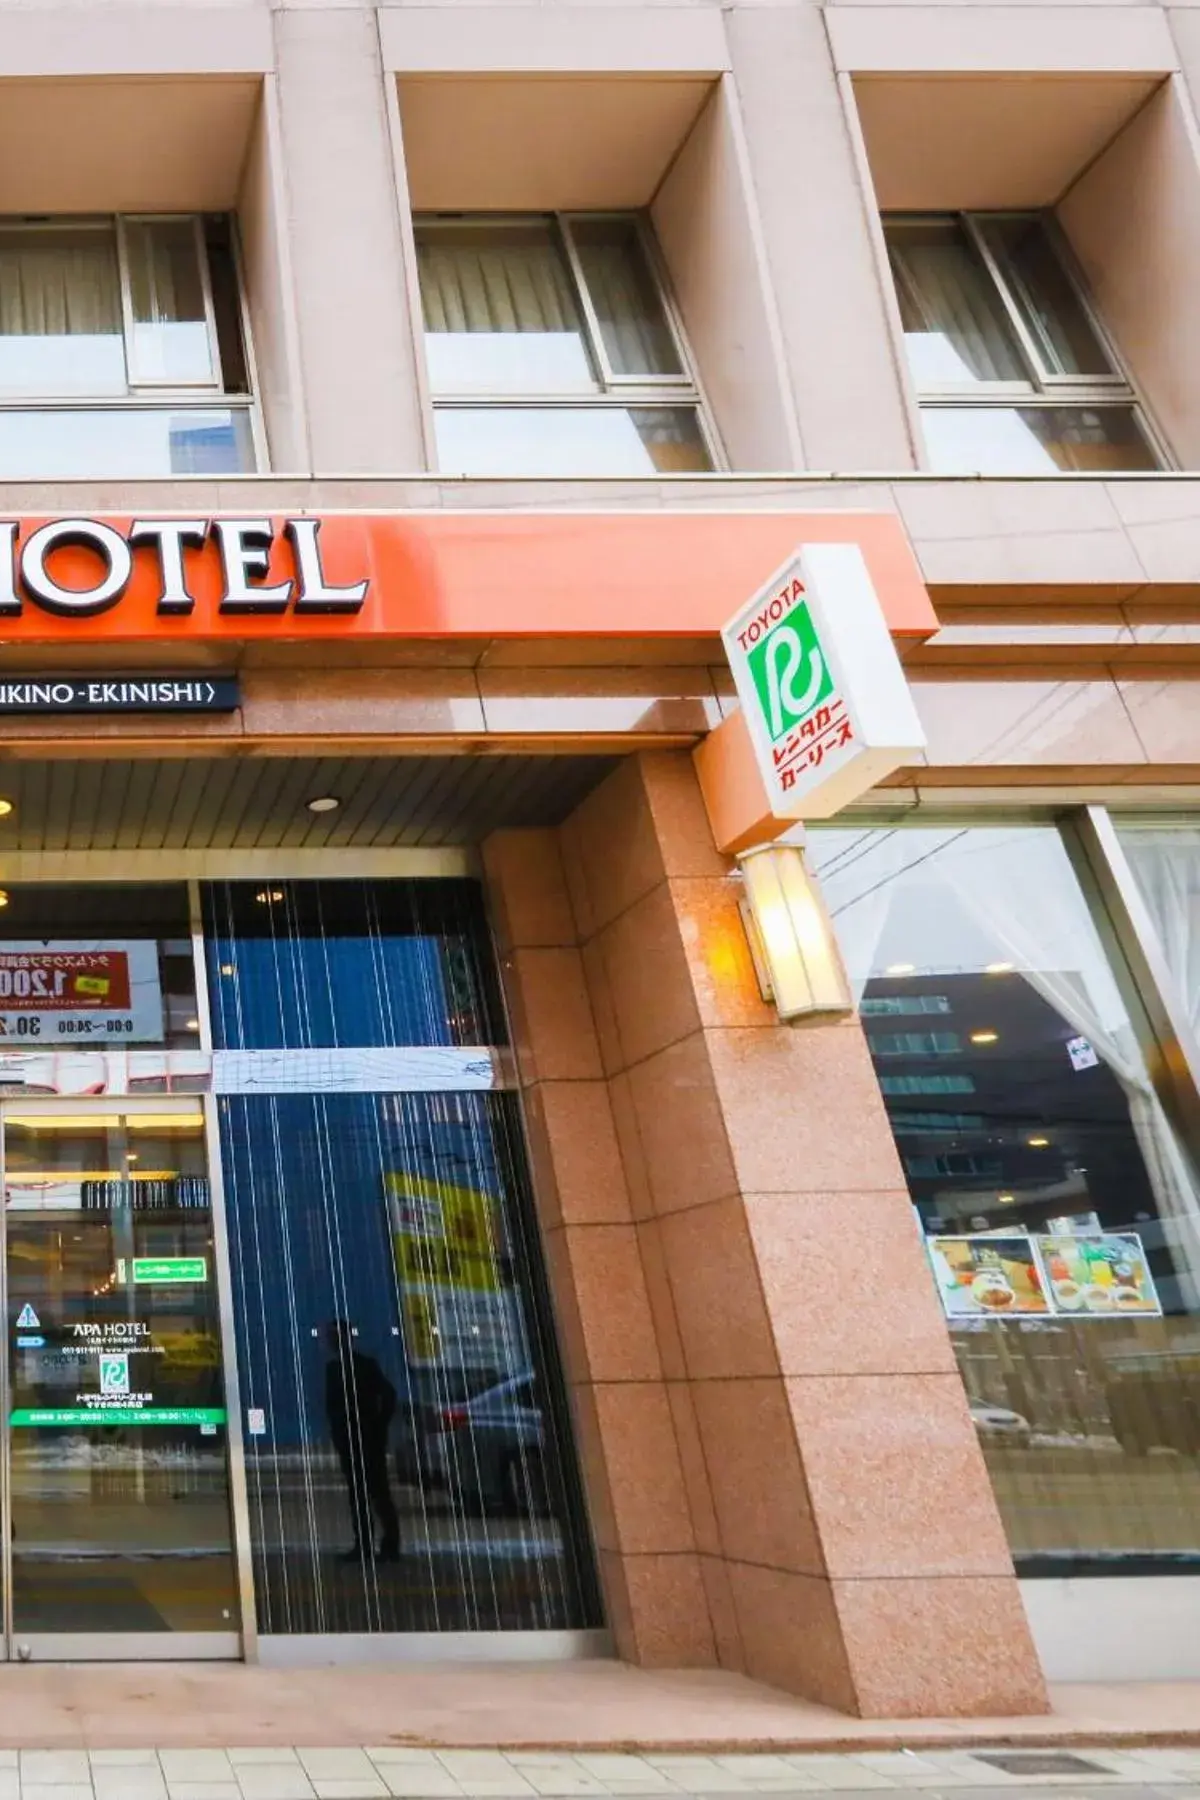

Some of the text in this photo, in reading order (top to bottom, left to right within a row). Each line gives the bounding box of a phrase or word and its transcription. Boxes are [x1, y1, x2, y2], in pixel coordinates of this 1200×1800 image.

[737, 578, 805, 651] TOYOTA
[772, 699, 843, 766] レンタカー
[779, 721, 854, 791] カーリース
[73, 1322, 152, 1337] APA HOTEL
